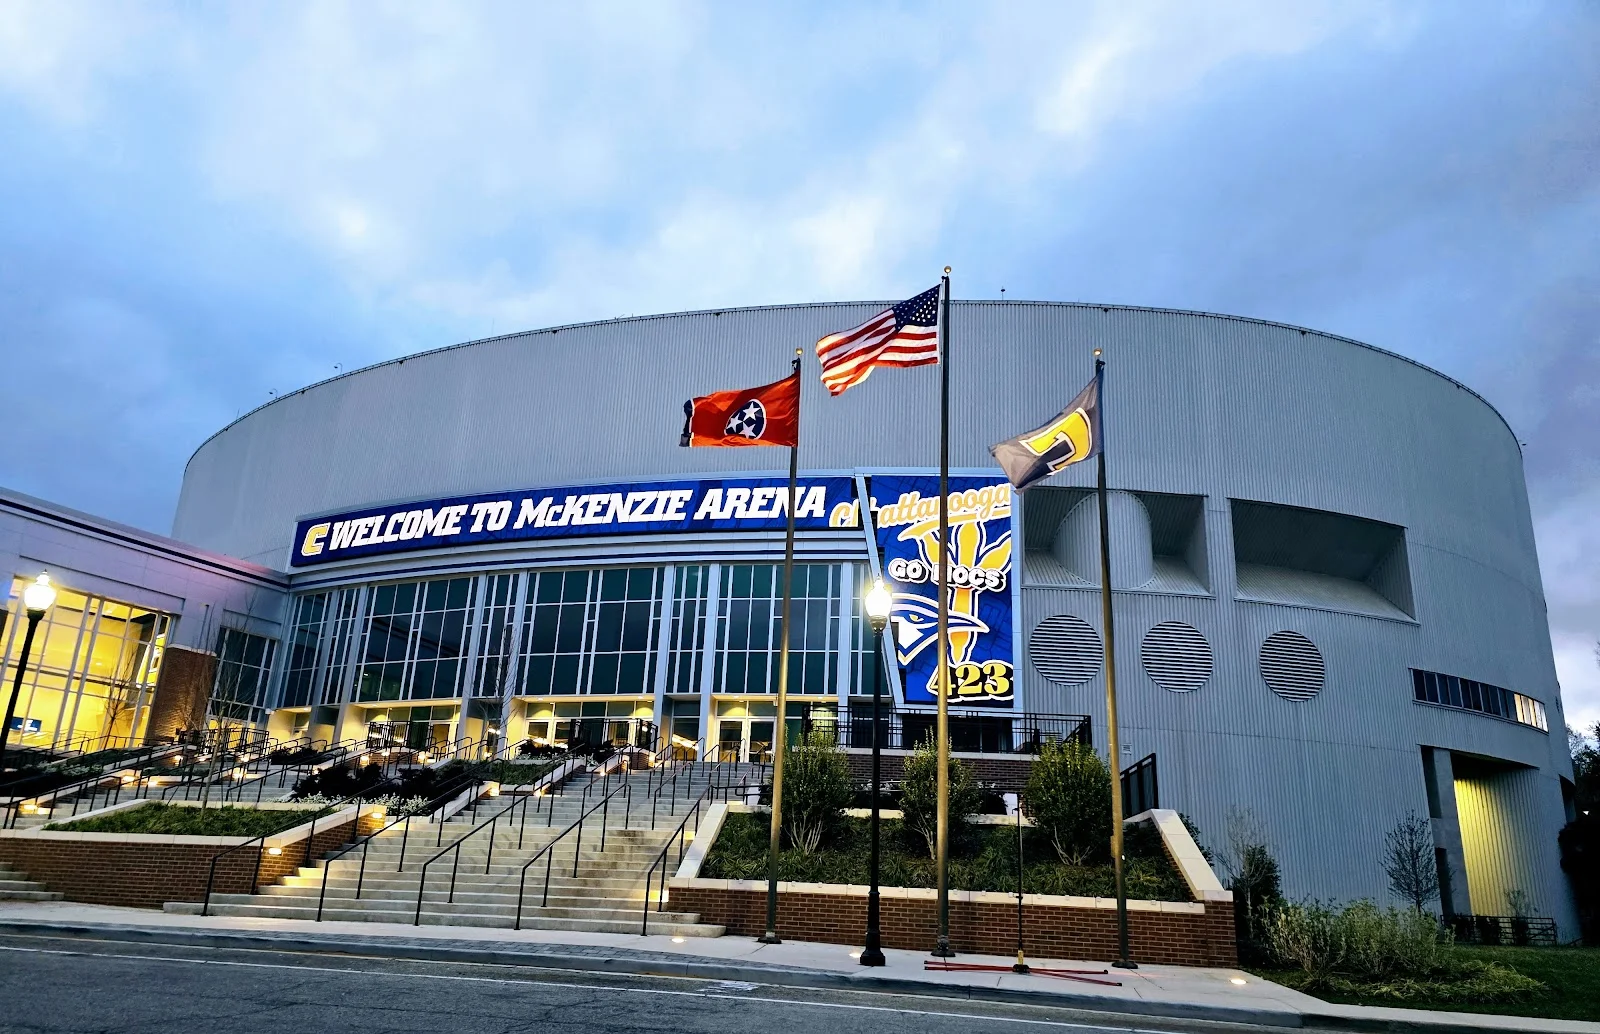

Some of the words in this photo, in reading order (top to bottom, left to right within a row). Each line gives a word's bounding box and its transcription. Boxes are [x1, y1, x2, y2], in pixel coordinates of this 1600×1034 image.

[329, 504, 469, 550] WELCOME
[470, 500, 513, 533] TO
[512, 489, 694, 530] McKENZIE
[693, 486, 827, 520] ARENA
[829, 484, 1011, 528] Cattaooga
[889, 559, 929, 581] GO
[929, 662, 1010, 697] 423
